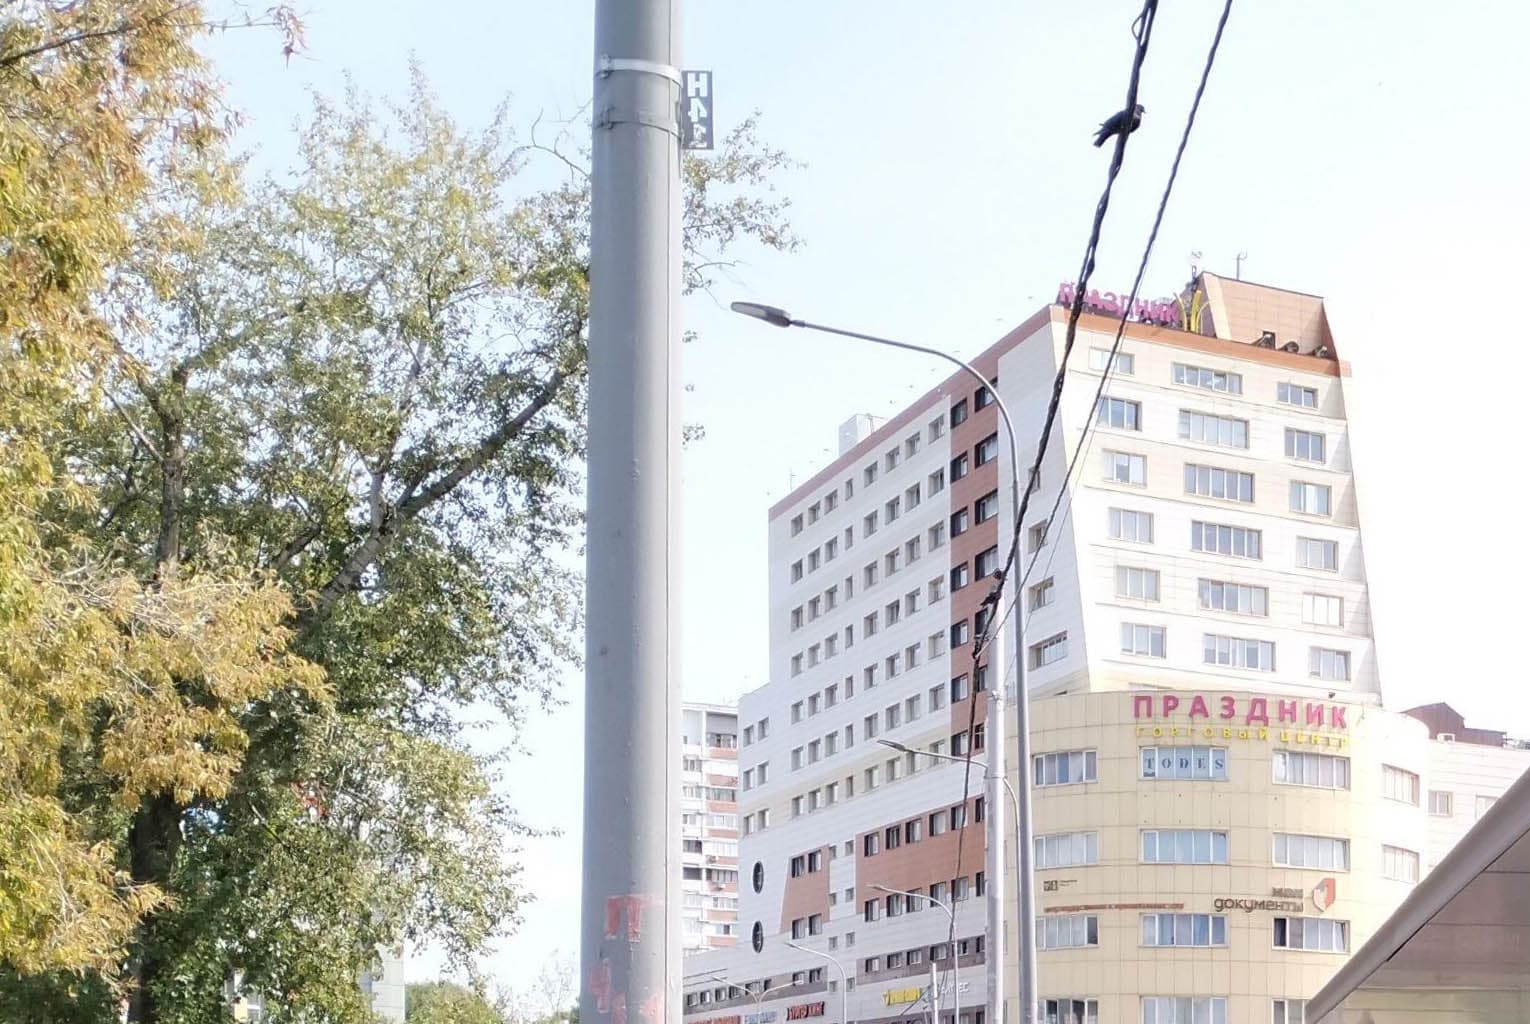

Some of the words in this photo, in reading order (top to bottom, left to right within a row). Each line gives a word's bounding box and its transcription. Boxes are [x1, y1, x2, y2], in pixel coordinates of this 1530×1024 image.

[1133, 694, 1348, 730] ПРАЗДНИК
[1143, 757, 1225, 770] TODES
[1213, 897, 1304, 914] документы
